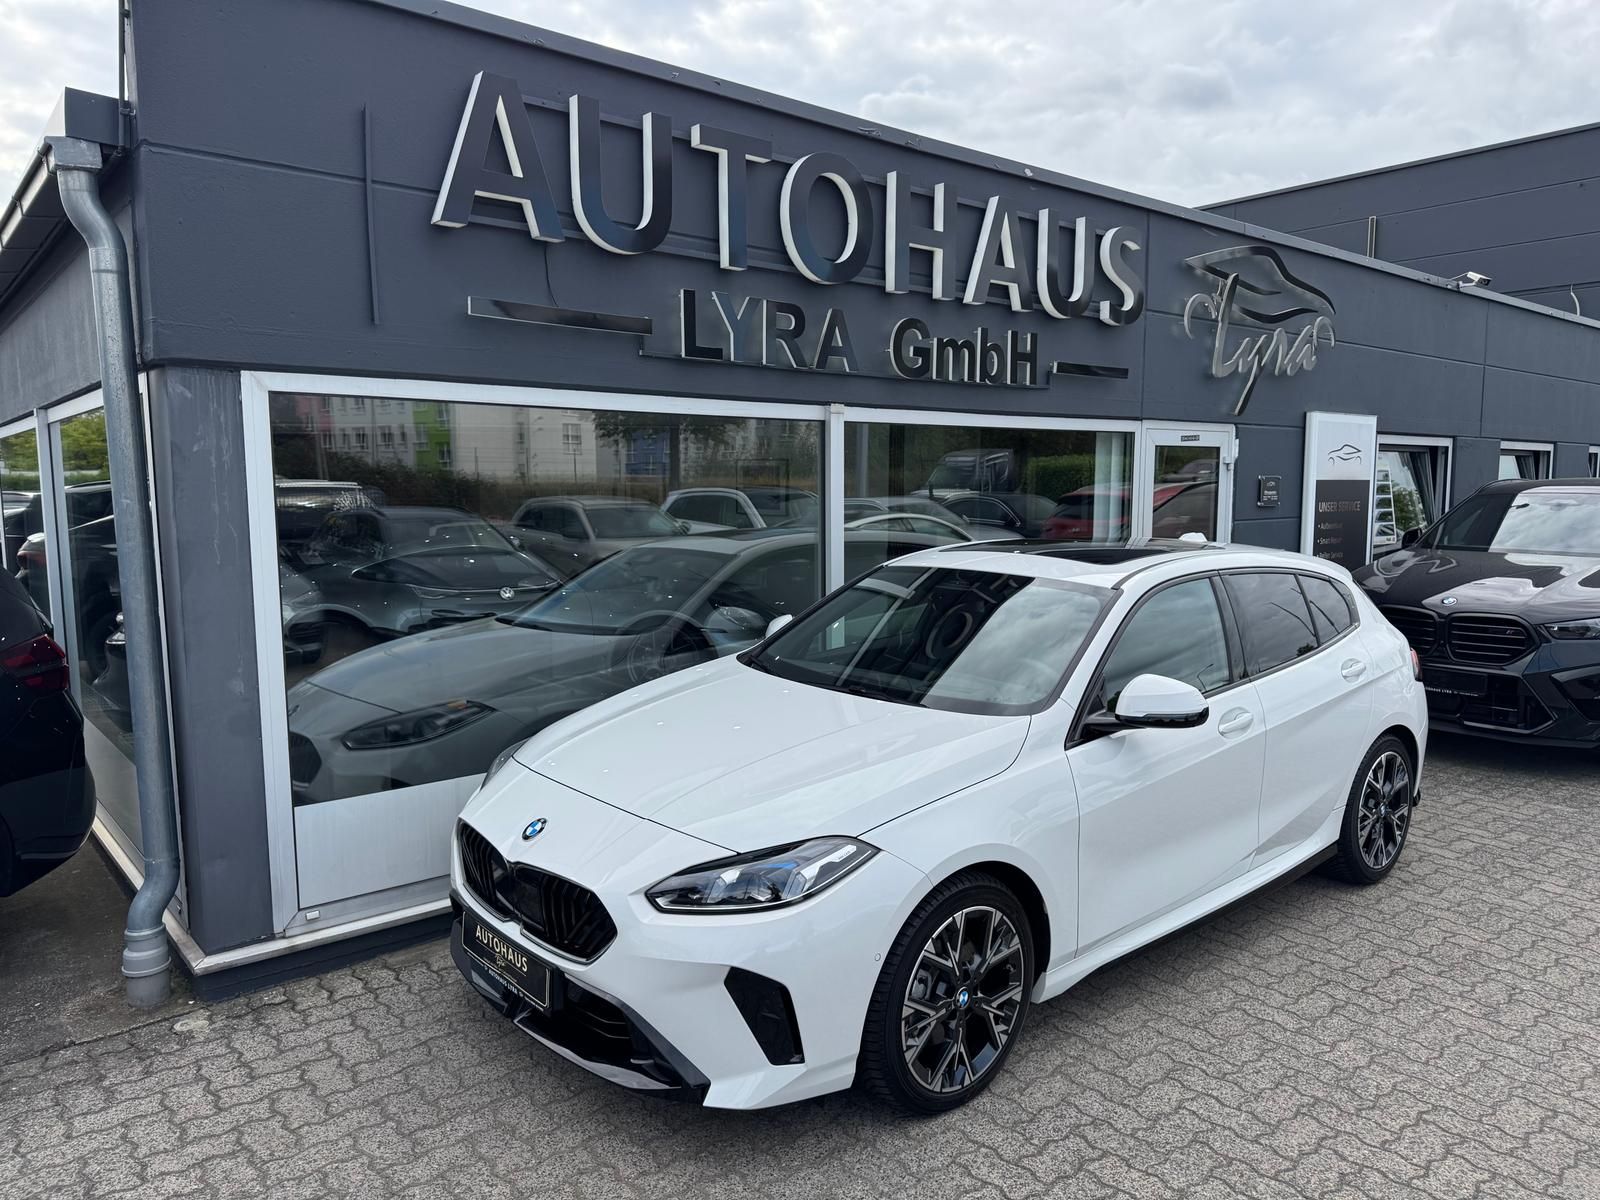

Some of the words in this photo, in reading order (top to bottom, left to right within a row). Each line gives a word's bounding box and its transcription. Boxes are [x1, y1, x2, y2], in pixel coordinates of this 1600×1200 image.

[431, 70, 1144, 327] AUTOHAUS
[679, 287, 859, 373] LYRA
[887, 316, 1039, 386] GmbH
[1318, 501, 1338, 513] UNSER
[476, 925, 527, 972] AUTOHAUS
